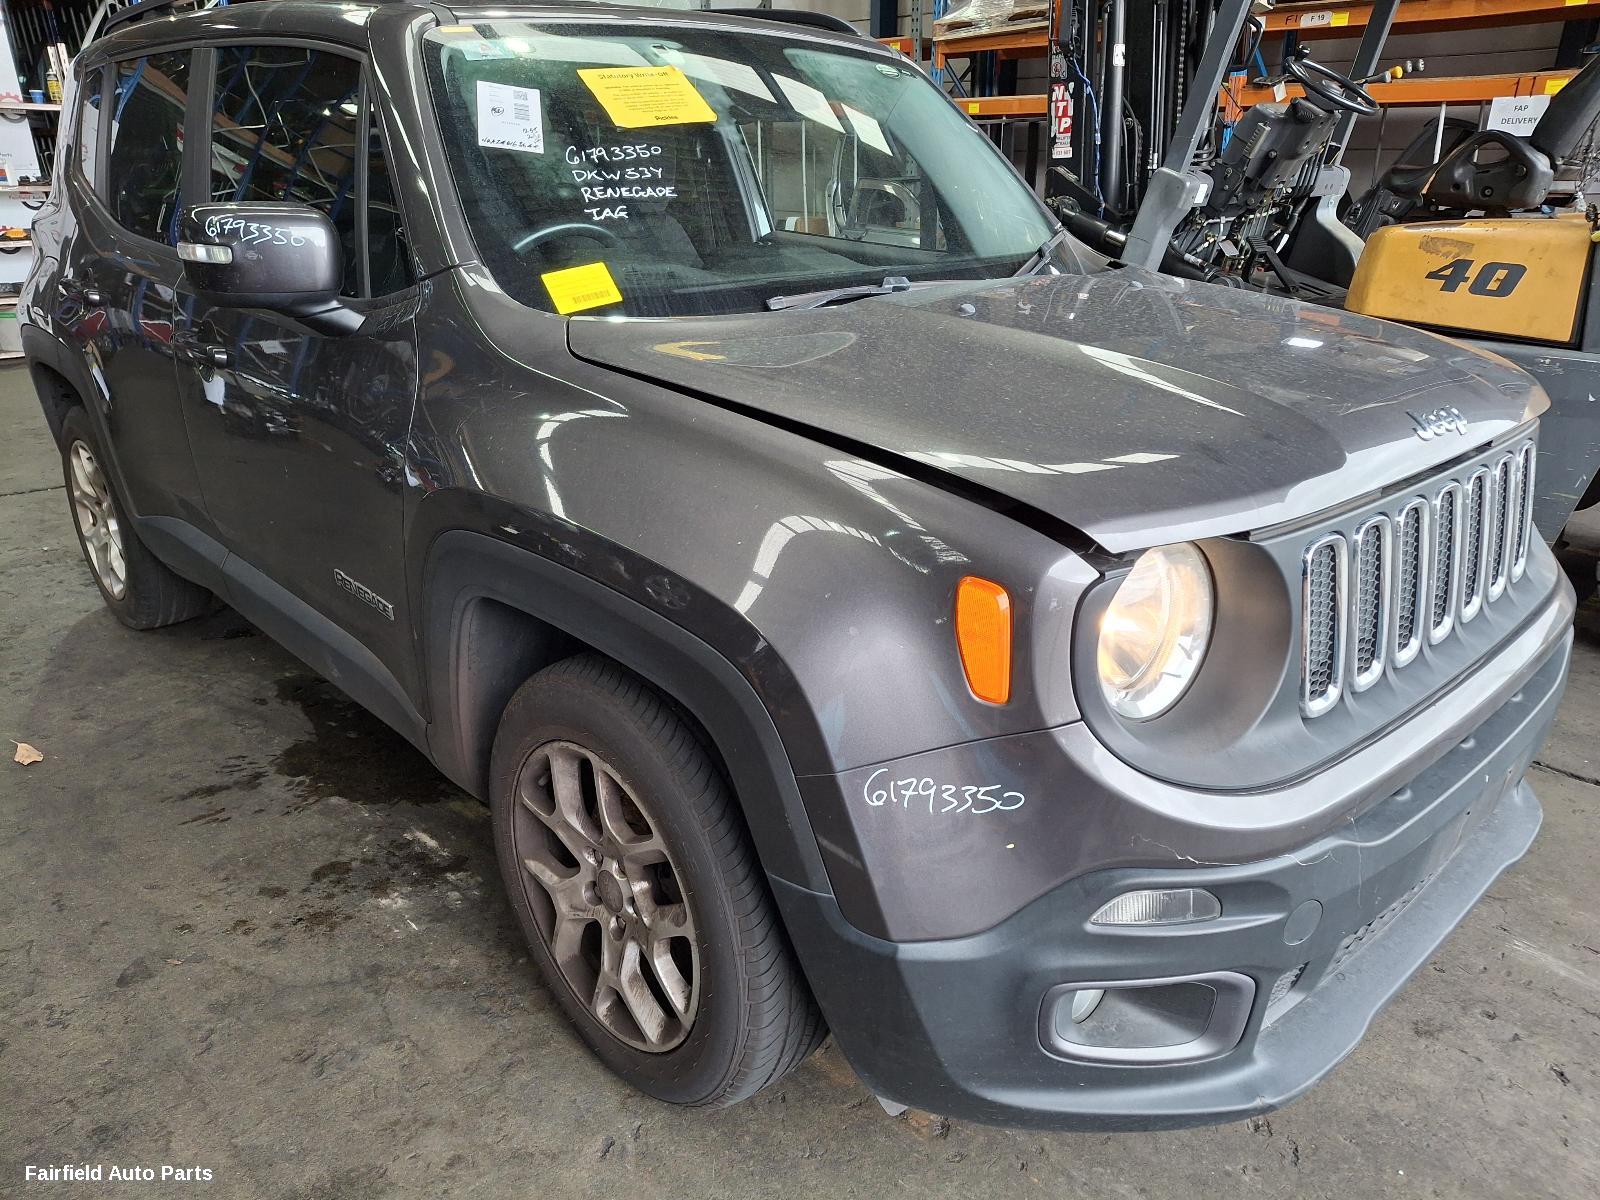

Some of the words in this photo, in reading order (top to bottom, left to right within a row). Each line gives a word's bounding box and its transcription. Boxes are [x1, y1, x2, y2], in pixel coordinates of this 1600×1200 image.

[598, 72, 634, 80] Statutory
[1500, 116, 1538, 125] DELIVERY
[1513, 104, 1529, 112] FAP
[565, 144, 662, 165] 61793350
[580, 186, 678, 203] RENEGADE
[205, 216, 305, 247] 61793350
[1424, 258, 1529, 298] 40
[1406, 404, 1468, 441] Jeep
[334, 568, 395, 621] RENEGADE
[864, 768, 1025, 814] 61793350
